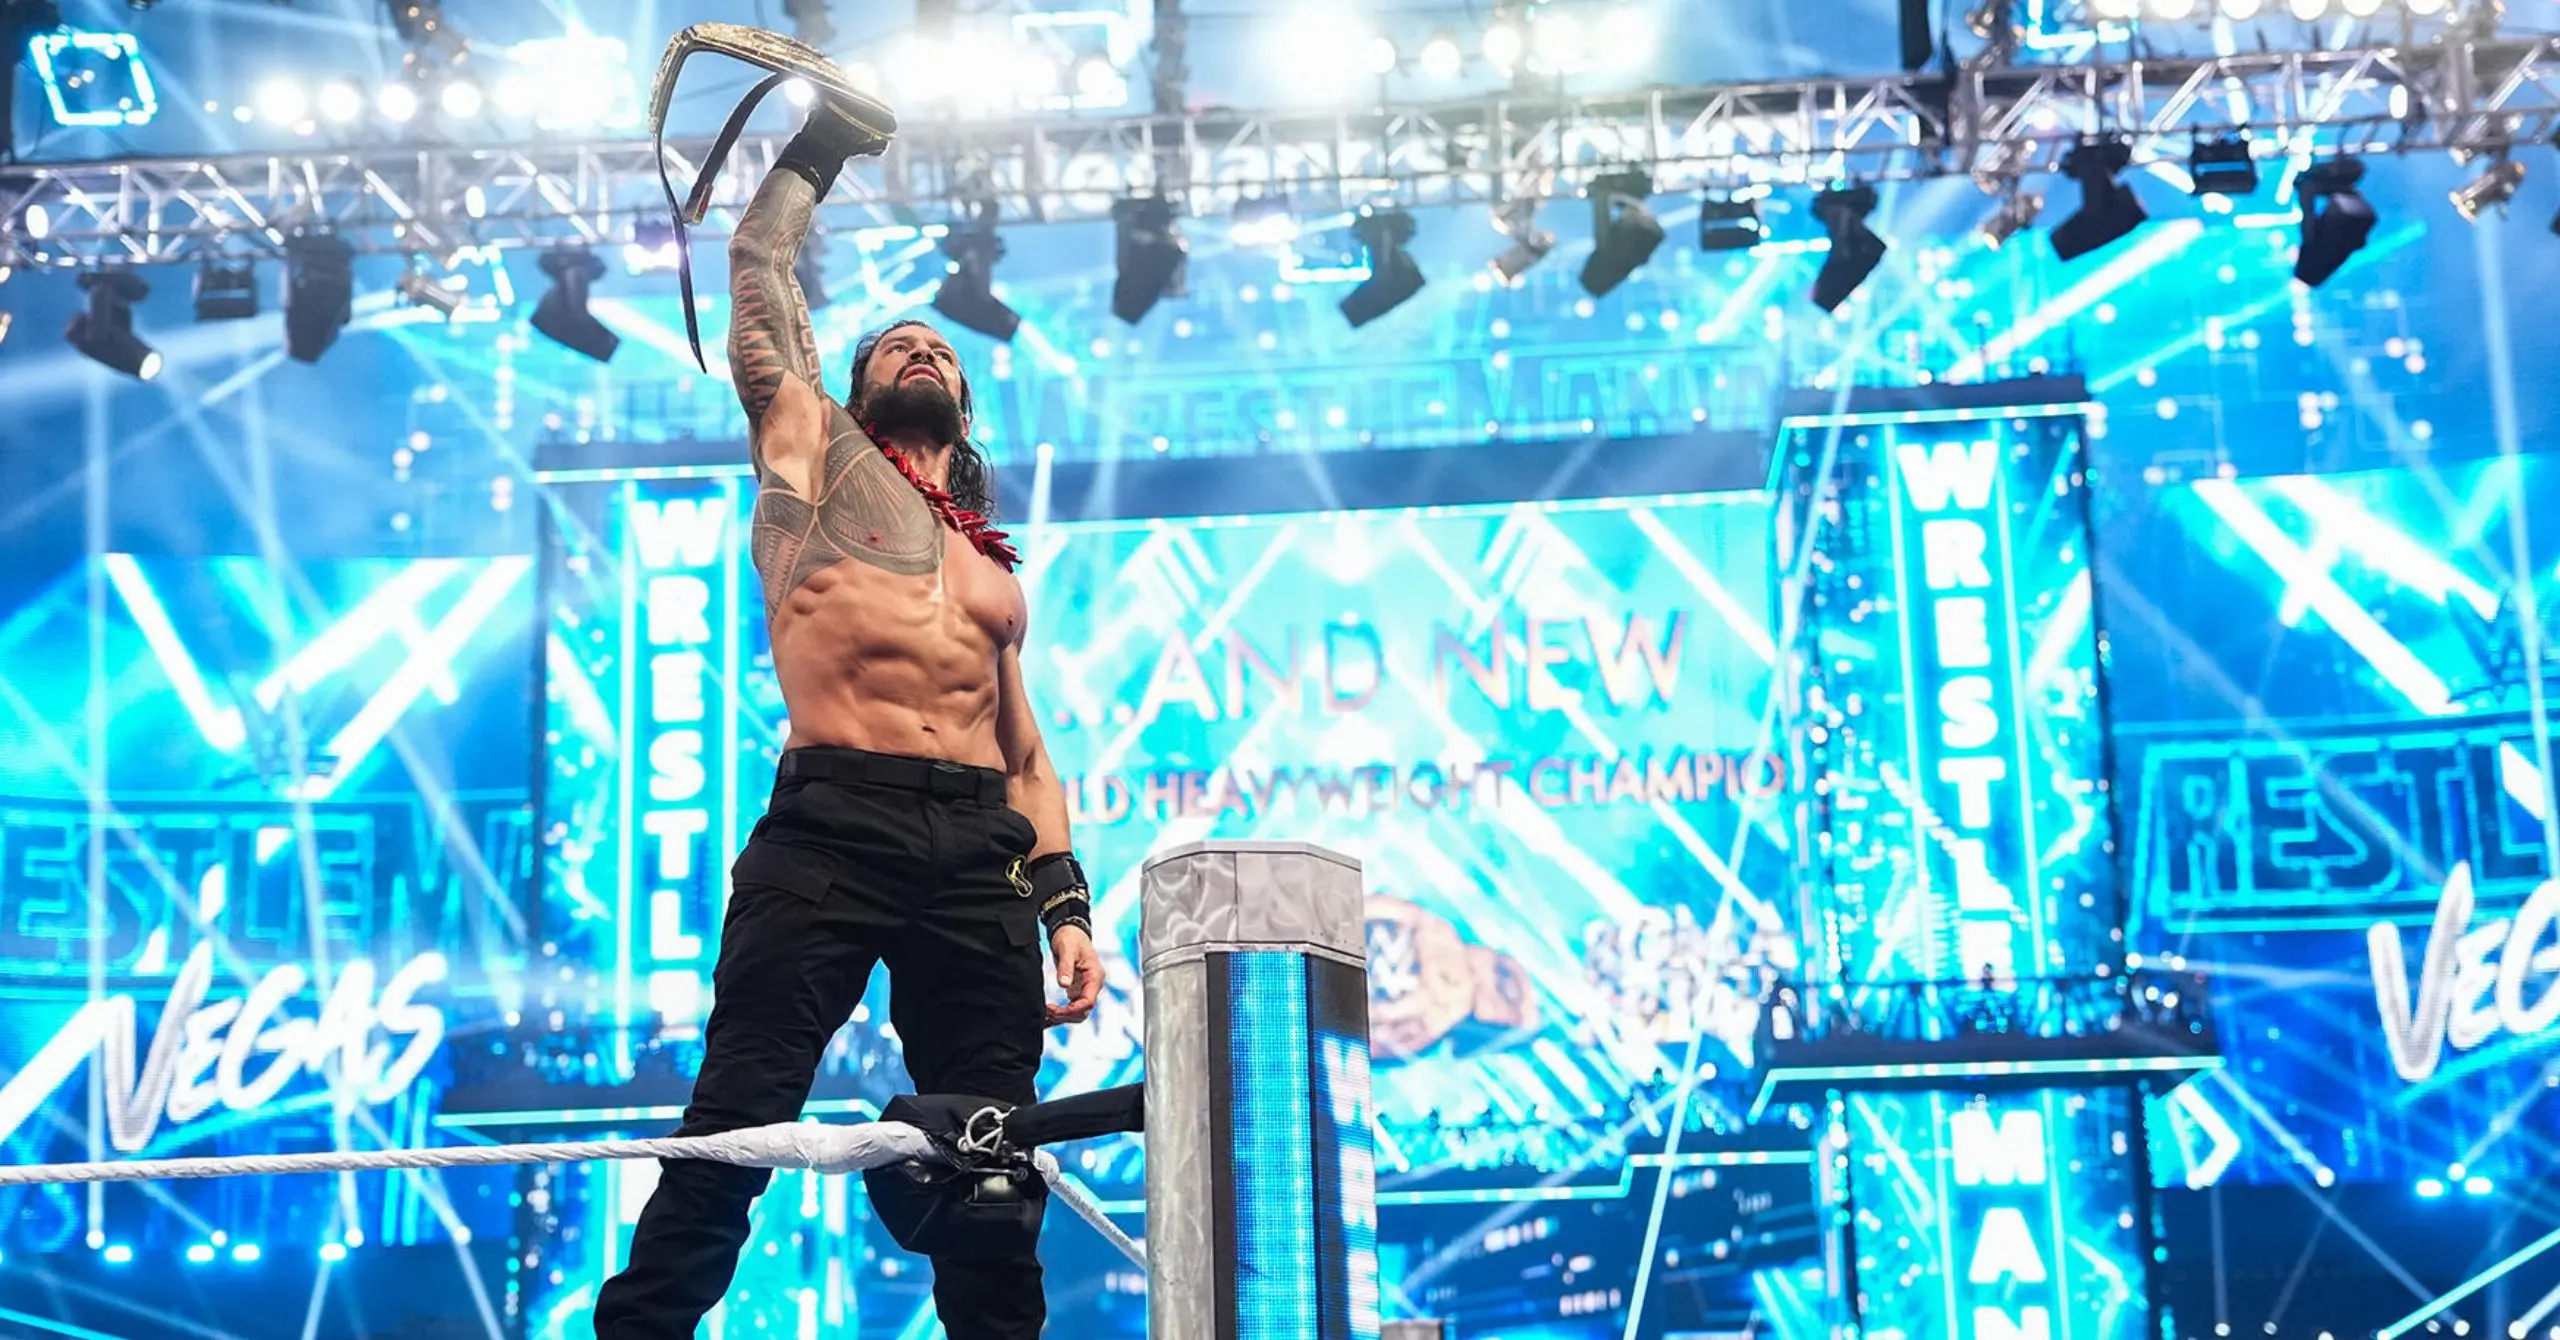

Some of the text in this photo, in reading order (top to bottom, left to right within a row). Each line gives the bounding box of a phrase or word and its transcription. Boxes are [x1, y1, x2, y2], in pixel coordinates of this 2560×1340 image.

[1432, 608, 1692, 712] NEW
[1897, 440, 2017, 992] WRESTLE
[1145, 758, 1512, 820] HEAVYWEIGHT
[103, 940, 446, 1152] VEGAS
